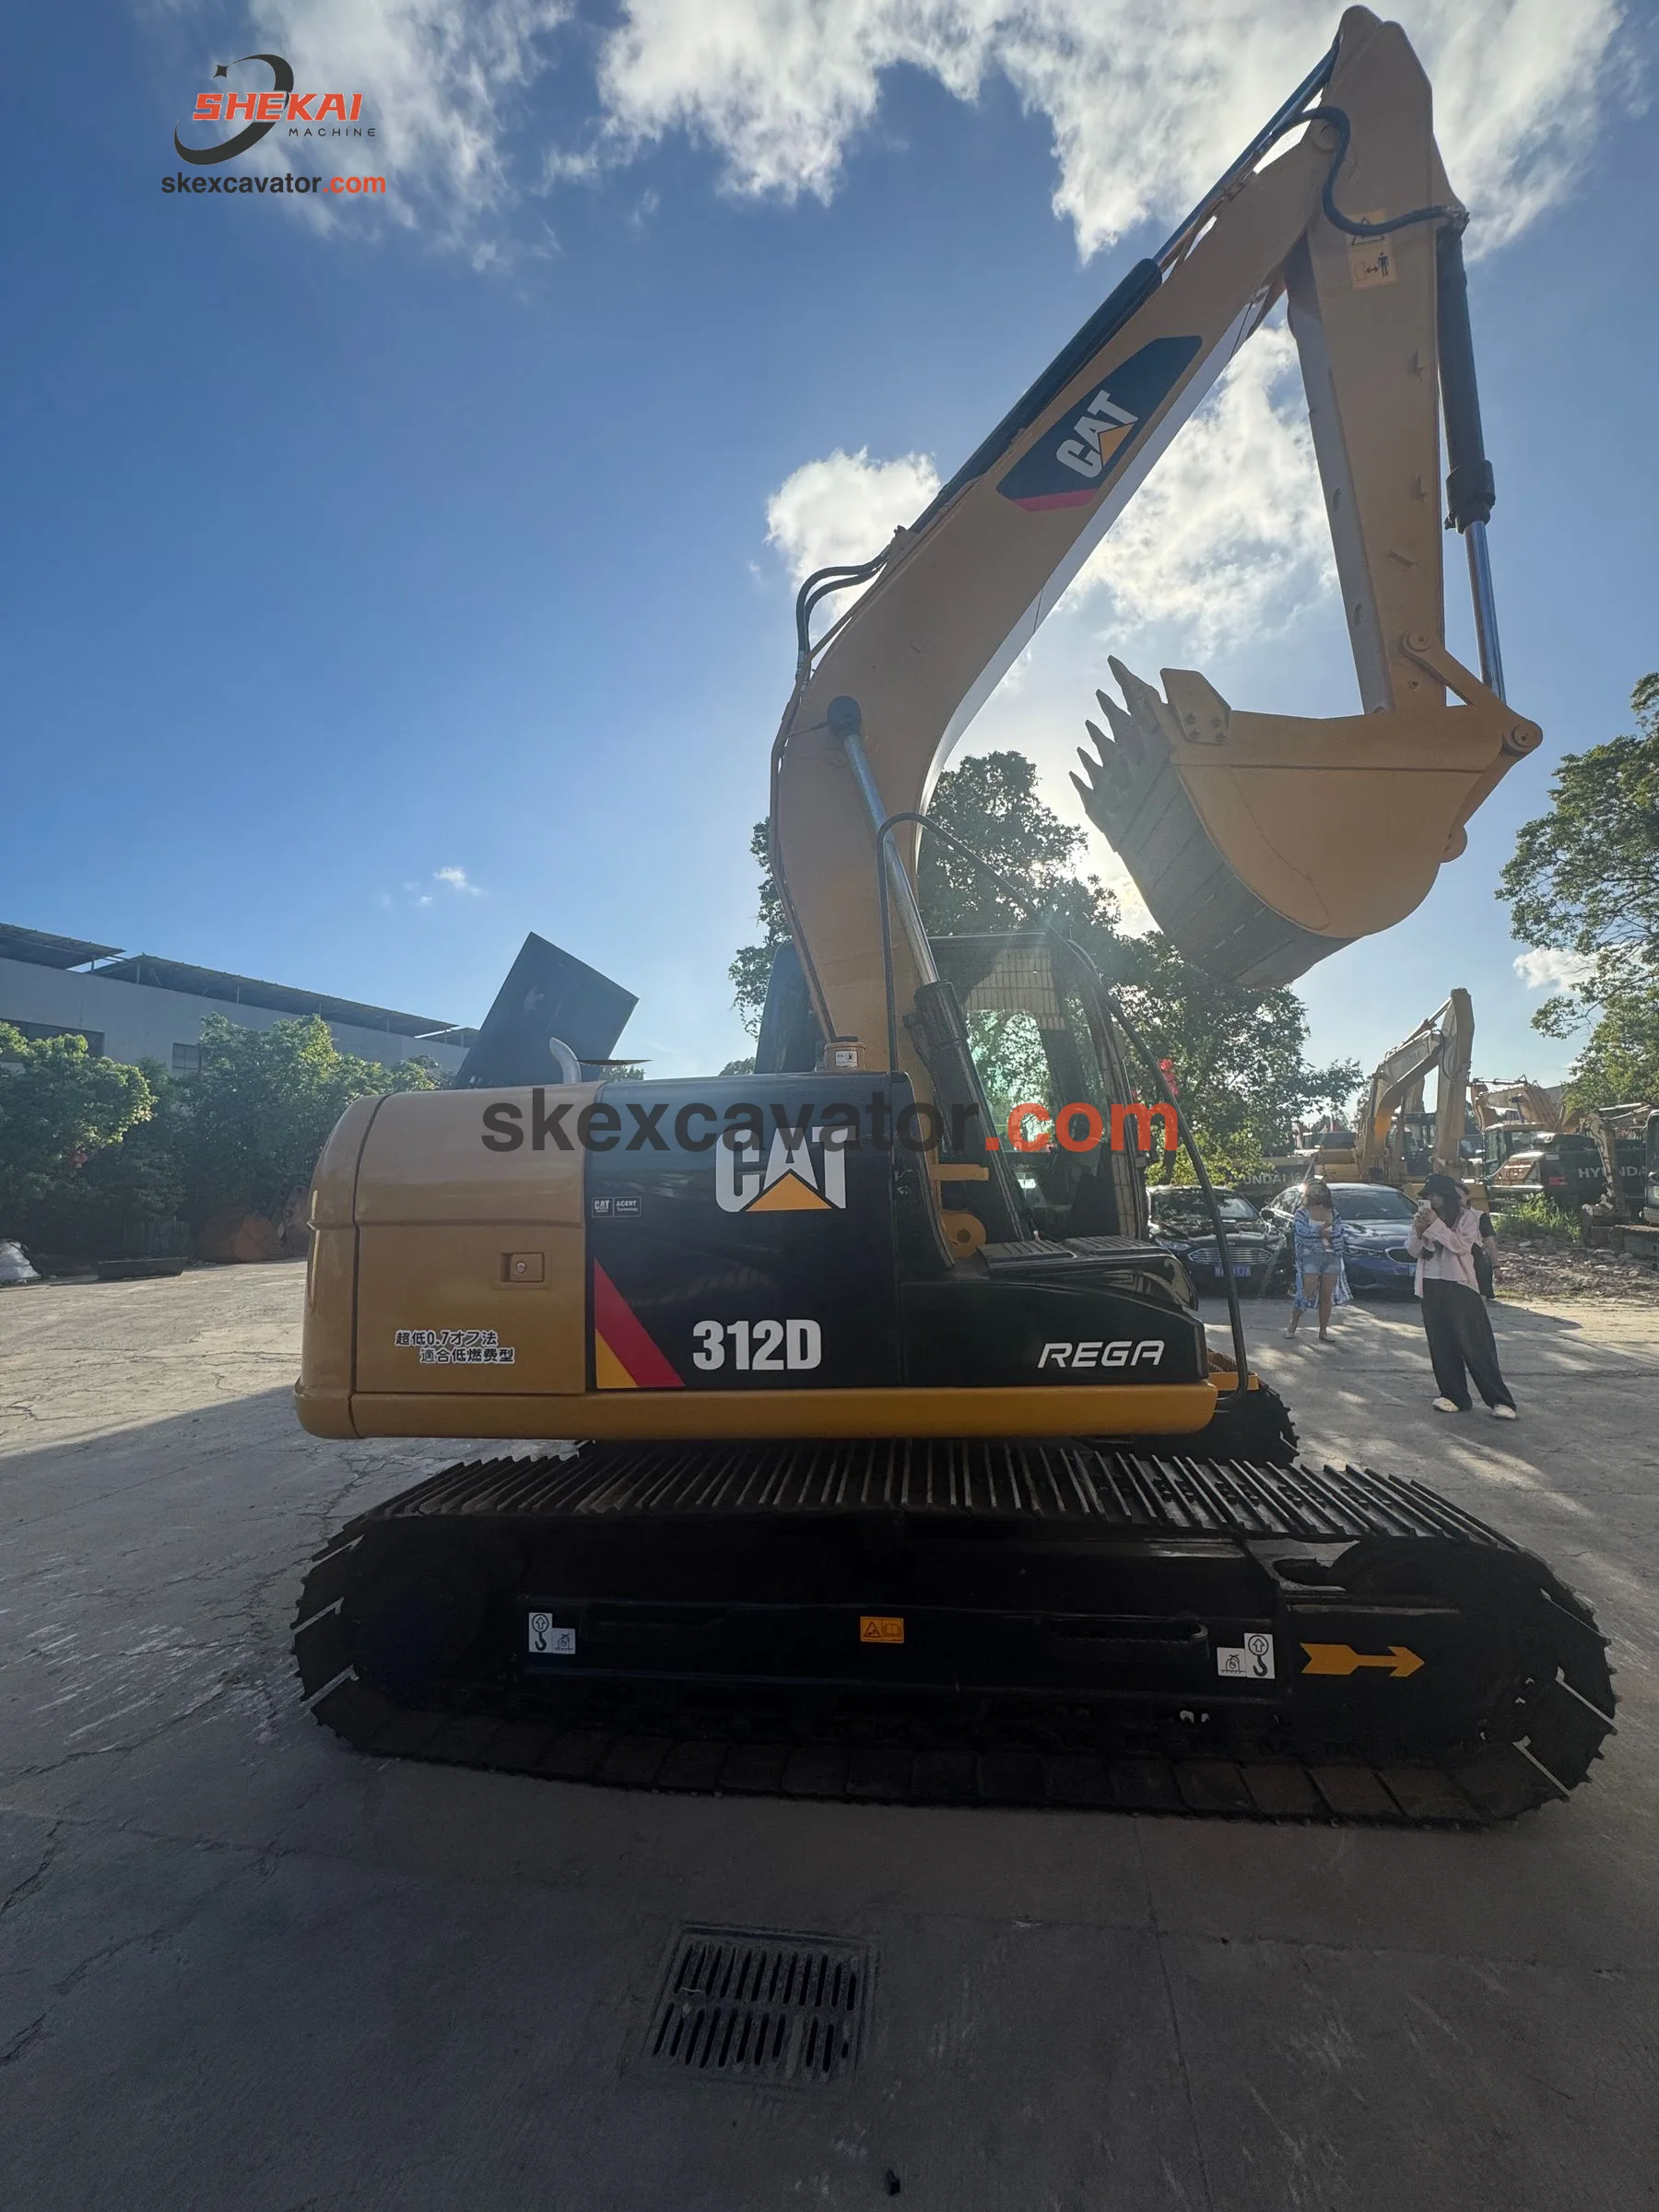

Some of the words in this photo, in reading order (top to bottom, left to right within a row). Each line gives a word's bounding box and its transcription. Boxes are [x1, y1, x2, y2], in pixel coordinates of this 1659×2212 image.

[1056, 390, 1138, 478] CAT
[715, 1124, 856, 1213] CAT
[594, 1200, 610, 1210] CAT
[692, 1319, 822, 1371] 312D
[1037, 1340, 1165, 1369] REGA
